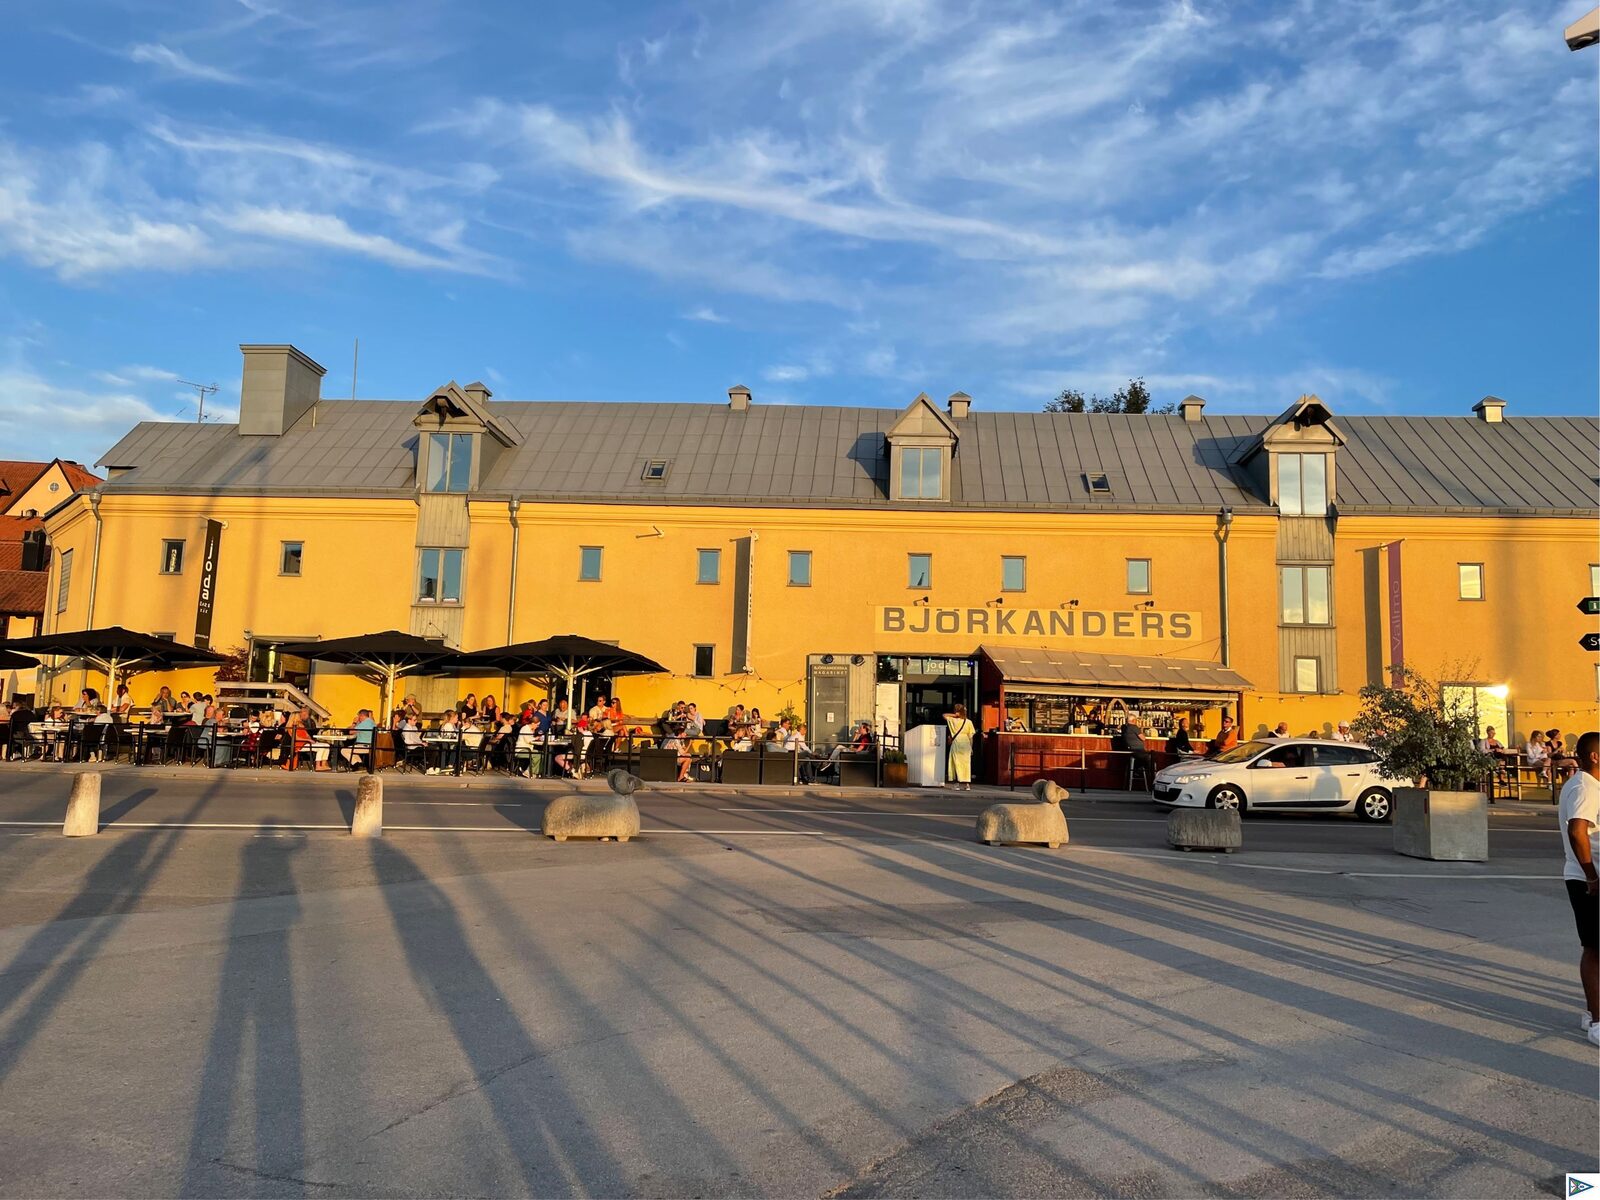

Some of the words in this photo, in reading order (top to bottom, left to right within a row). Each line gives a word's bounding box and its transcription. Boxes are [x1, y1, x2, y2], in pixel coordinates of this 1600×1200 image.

[201, 538, 214, 600] joda
[883, 606, 1192, 639] BJÖRKANDERS
[1391, 580, 1401, 650] Vallmo
